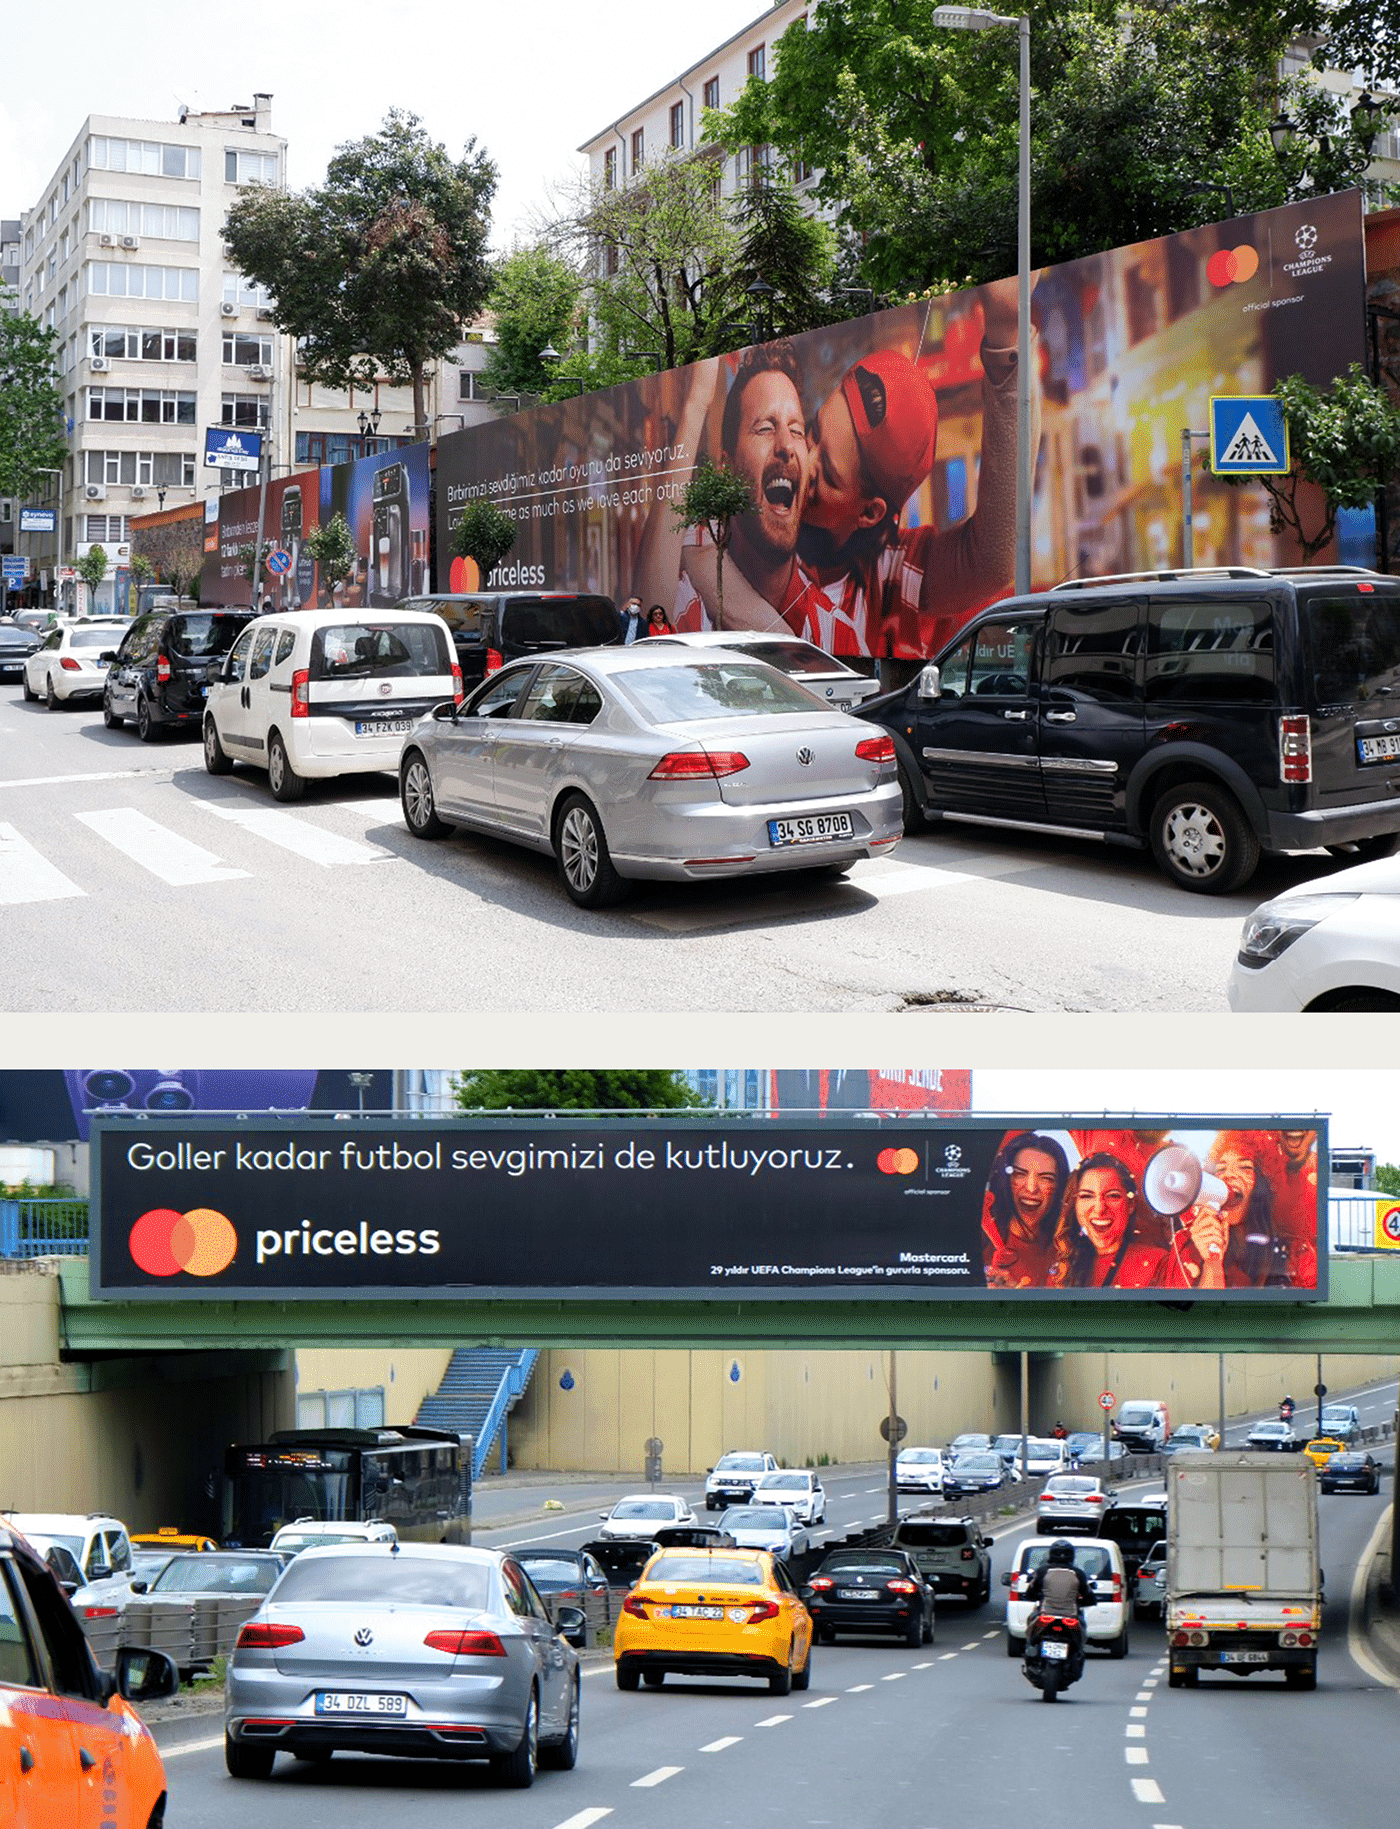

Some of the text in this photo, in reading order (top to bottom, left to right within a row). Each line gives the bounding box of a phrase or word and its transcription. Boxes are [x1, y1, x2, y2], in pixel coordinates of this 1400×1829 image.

[1283, 255, 1333, 272] CHAMPIONS
[1292, 265, 1324, 277] LEAGUE
[1242, 295, 1305, 313] official sponsor
[538, 465, 567, 484] kadar
[569, 461, 602, 483] oyunu
[605, 452, 621, 471] da
[624, 442, 690, 470] seviyoruz.
[532, 499, 560, 518] much
[562, 498, 575, 513] as
[577, 495, 594, 512] we
[597, 488, 620, 509] love
[622, 486, 652, 506] each
[362, 723, 372, 733] 34
[778, 816, 848, 839] 34 SG 8708
[127, 1141, 855, 1176] Goller kadar futbol sevgimizi de kutluyoruz.
[256, 1219, 440, 1264] priceless
[899, 1252, 970, 1263] Mastercard.
[710, 1265, 723, 1275] 29
[724, 1265, 749, 1277] yıldır
[751, 1265, 779, 1275] UEFA
[781, 1265, 836, 1277] Champions
[885, 1265, 921, 1277] gururla
[922, 1266, 970, 1277] sponsoru.
[325, 1695, 402, 1711] 34 DZL 589
